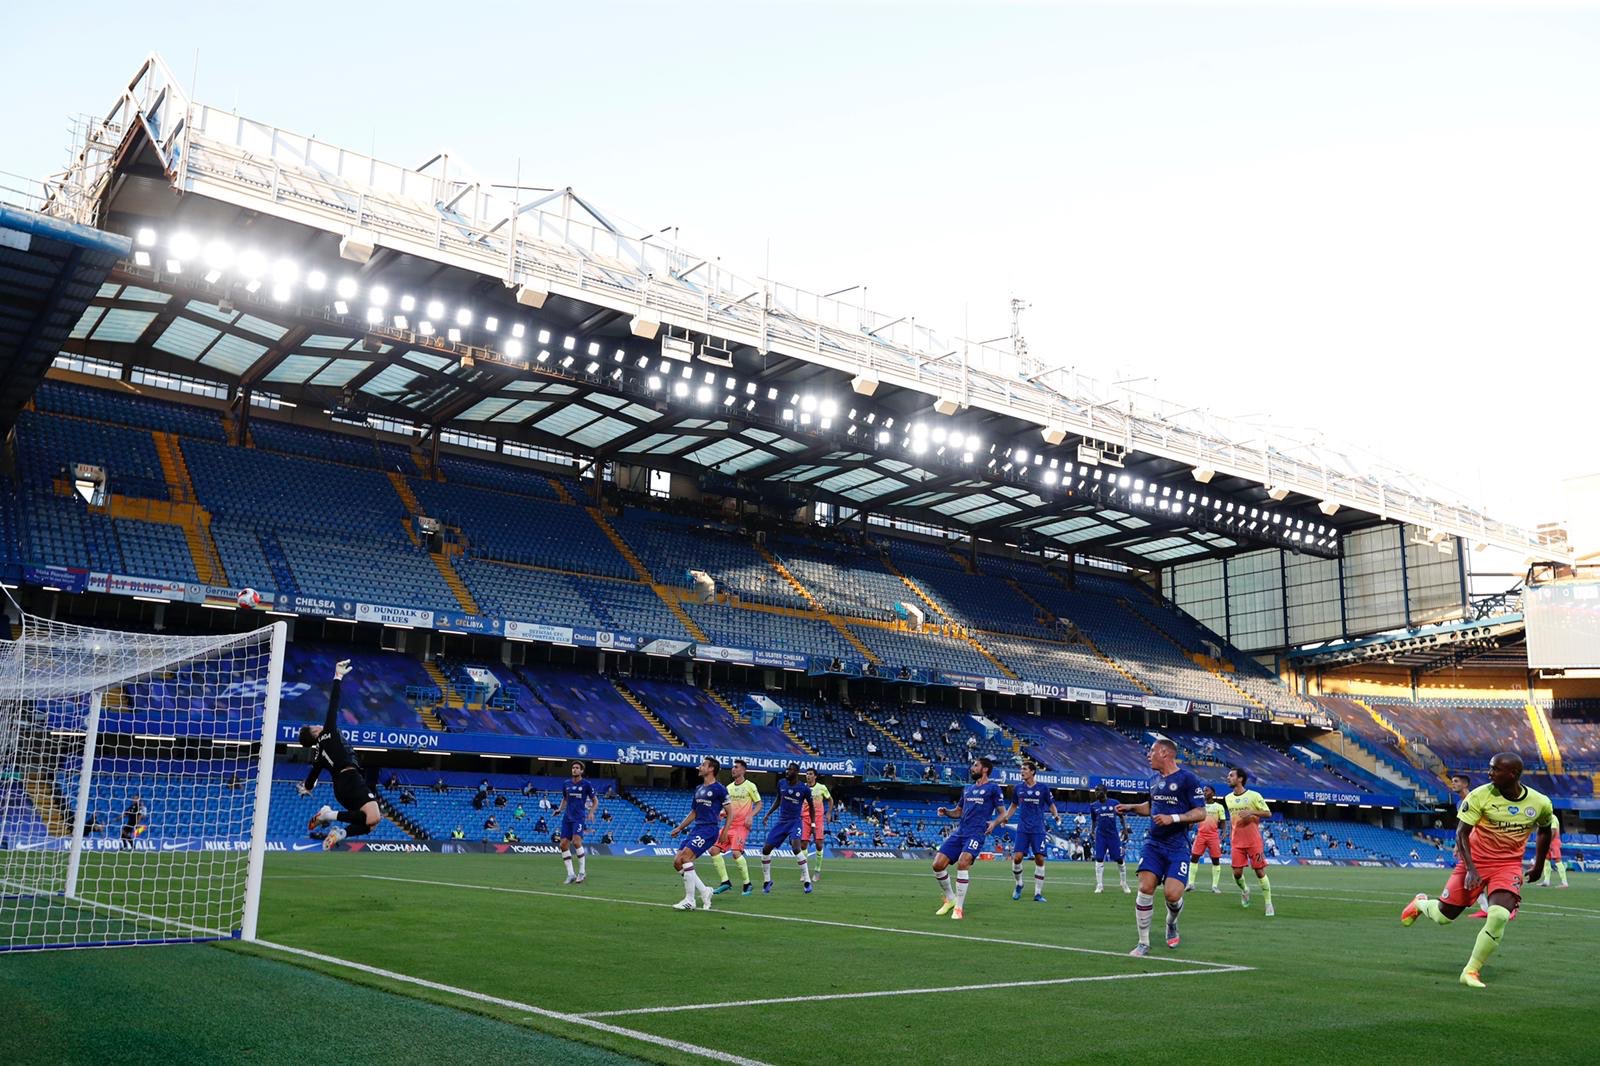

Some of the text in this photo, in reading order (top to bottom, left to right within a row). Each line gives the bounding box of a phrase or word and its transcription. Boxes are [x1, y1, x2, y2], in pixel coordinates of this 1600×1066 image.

[295, 597, 336, 609] CHELSEA
[373, 606, 417, 617] DUNDALK
[381, 615, 409, 624] BLUES
[1035, 683, 1059, 696] MIZO
[362, 731, 377, 743] OF
[380, 732, 439, 746] LONDON
[639, 750, 667, 761] THEY
[759, 758, 780, 768] LIKE
[800, 761, 844, 771] ANYMORE
[1101, 778, 1115, 787] THE
[1116, 779, 1137, 789] PRIDE
[1304, 791, 1315, 799] THE
[1315, 792, 1331, 801] PRIDE
[1338, 794, 1361, 802] LONDON
[64, 839, 93, 850] NKE
[205, 840, 232, 851] NIKE
[692, 835, 705, 848] 28
[968, 839, 979, 850] 18
[367, 843, 430, 852] YOKOHAMA
[854, 851, 897, 859] YOKOHAMA
[1180, 861, 1188, 875] 8
